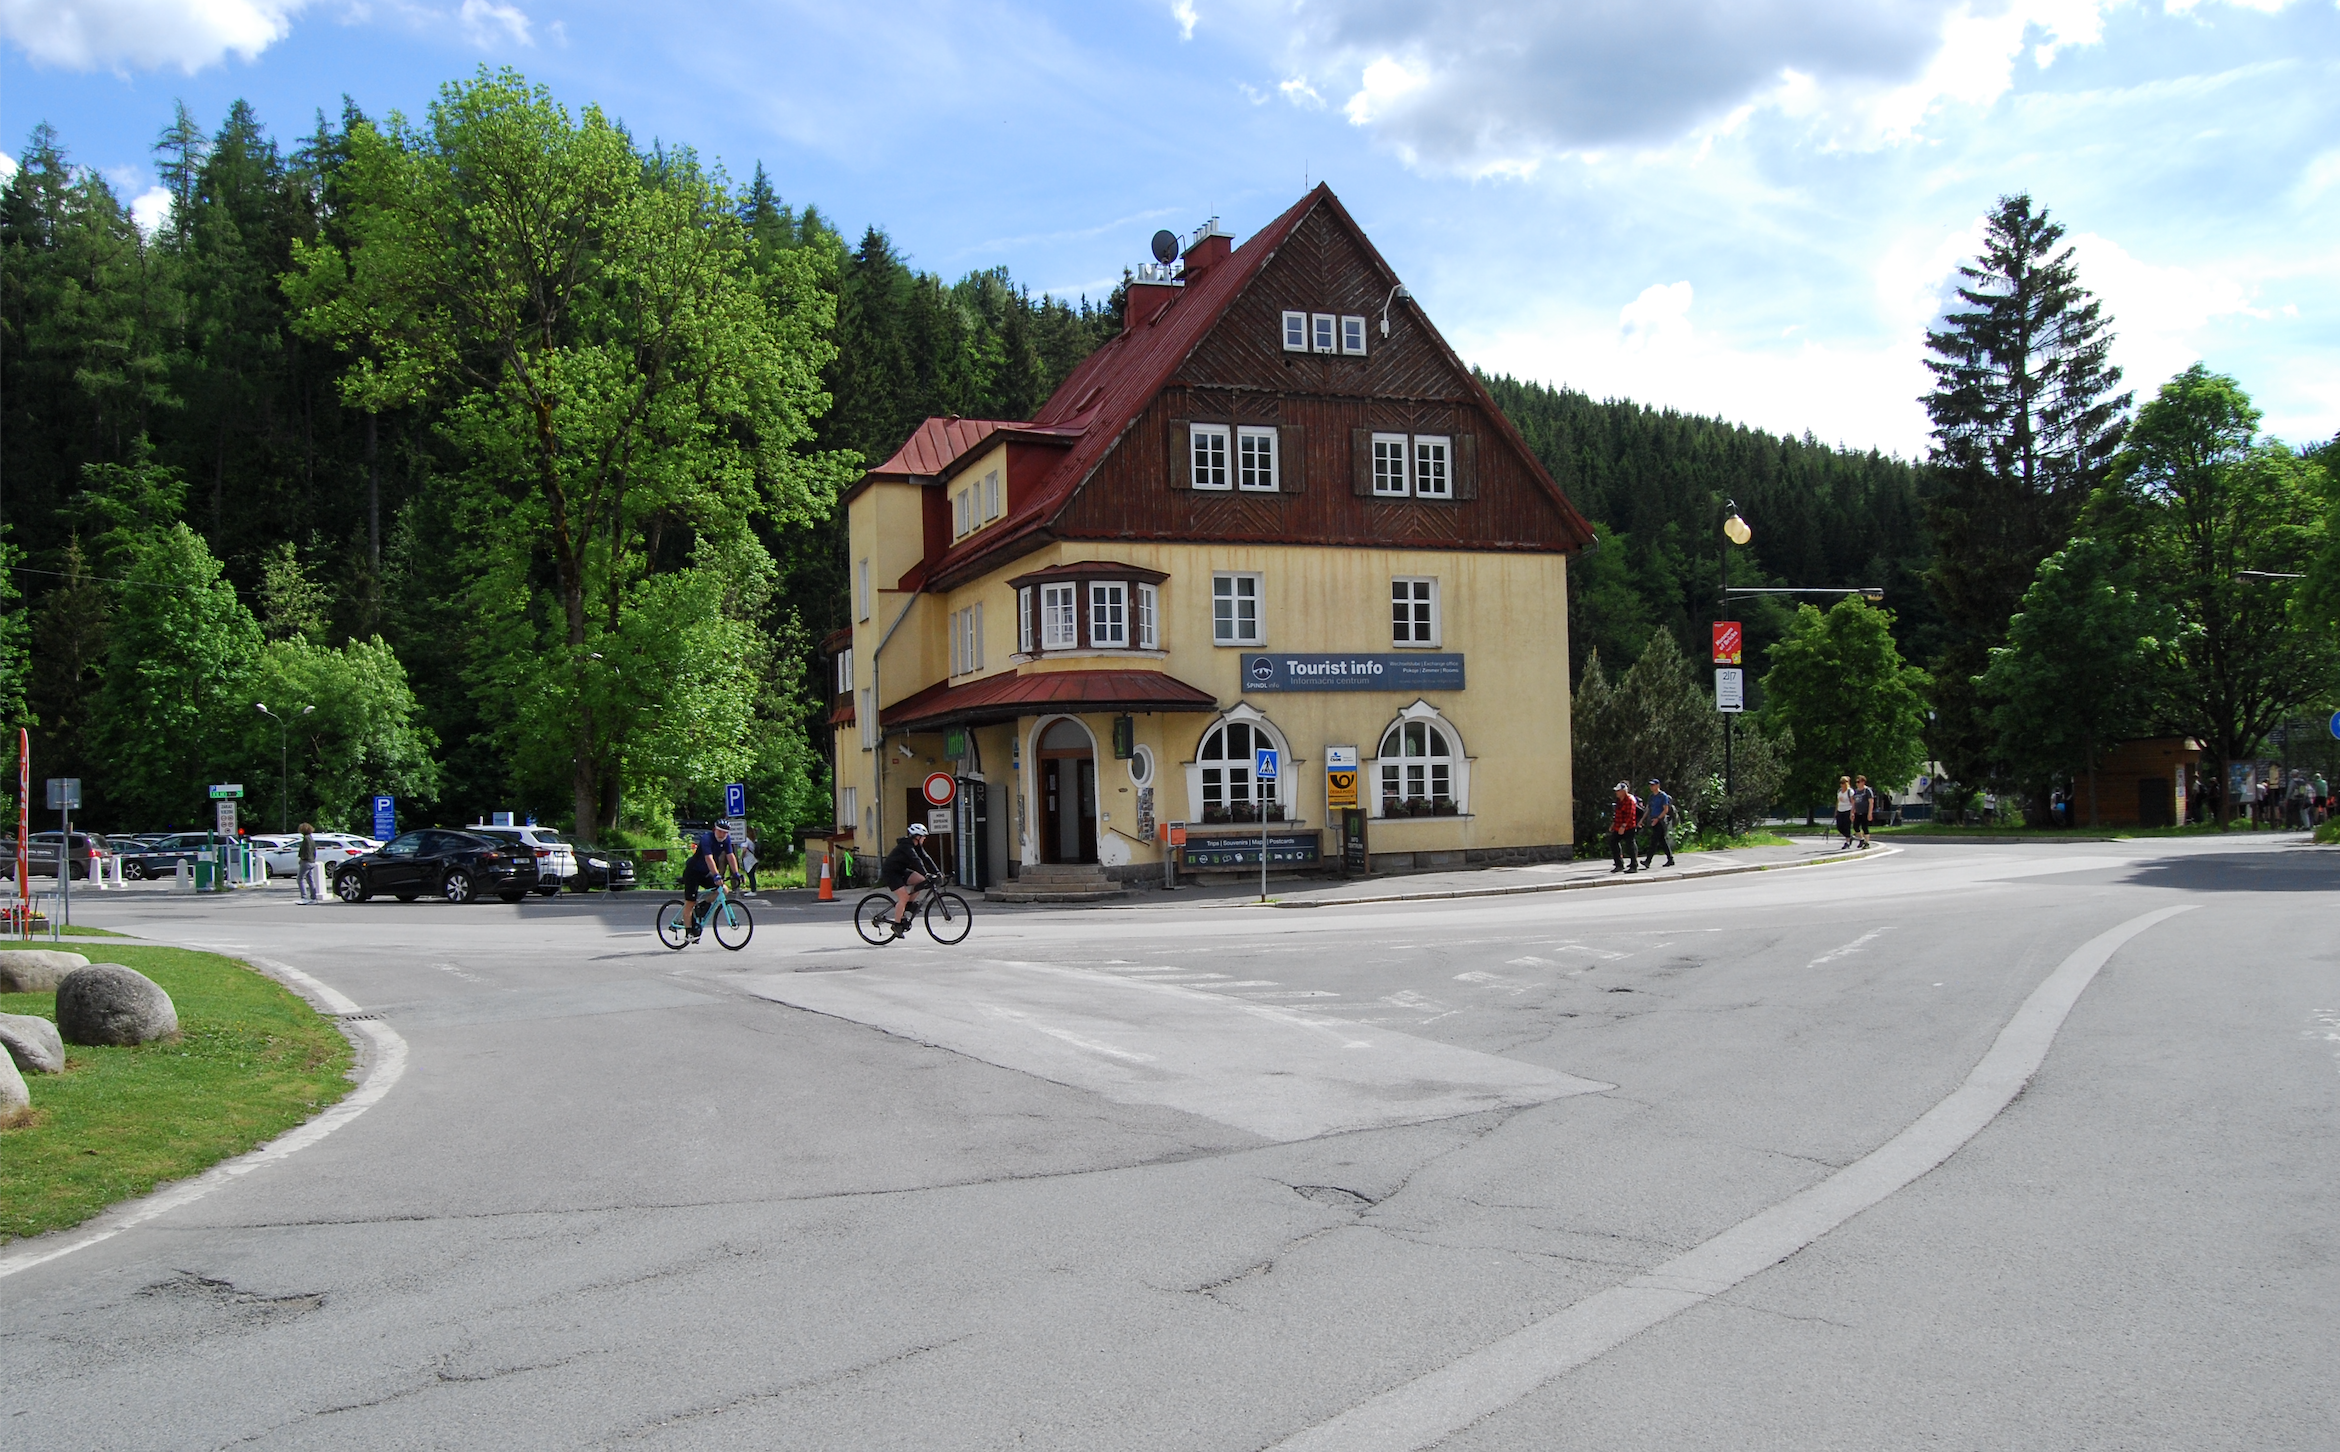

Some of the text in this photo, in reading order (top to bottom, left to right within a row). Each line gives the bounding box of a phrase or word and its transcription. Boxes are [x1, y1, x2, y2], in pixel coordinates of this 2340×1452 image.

[1286, 660, 1383, 675] Tourist info
[1290, 677, 1370, 685] Informační centrum
[947, 729, 964, 755] info
[378, 798, 391, 812] P
[730, 788, 741, 807] P
